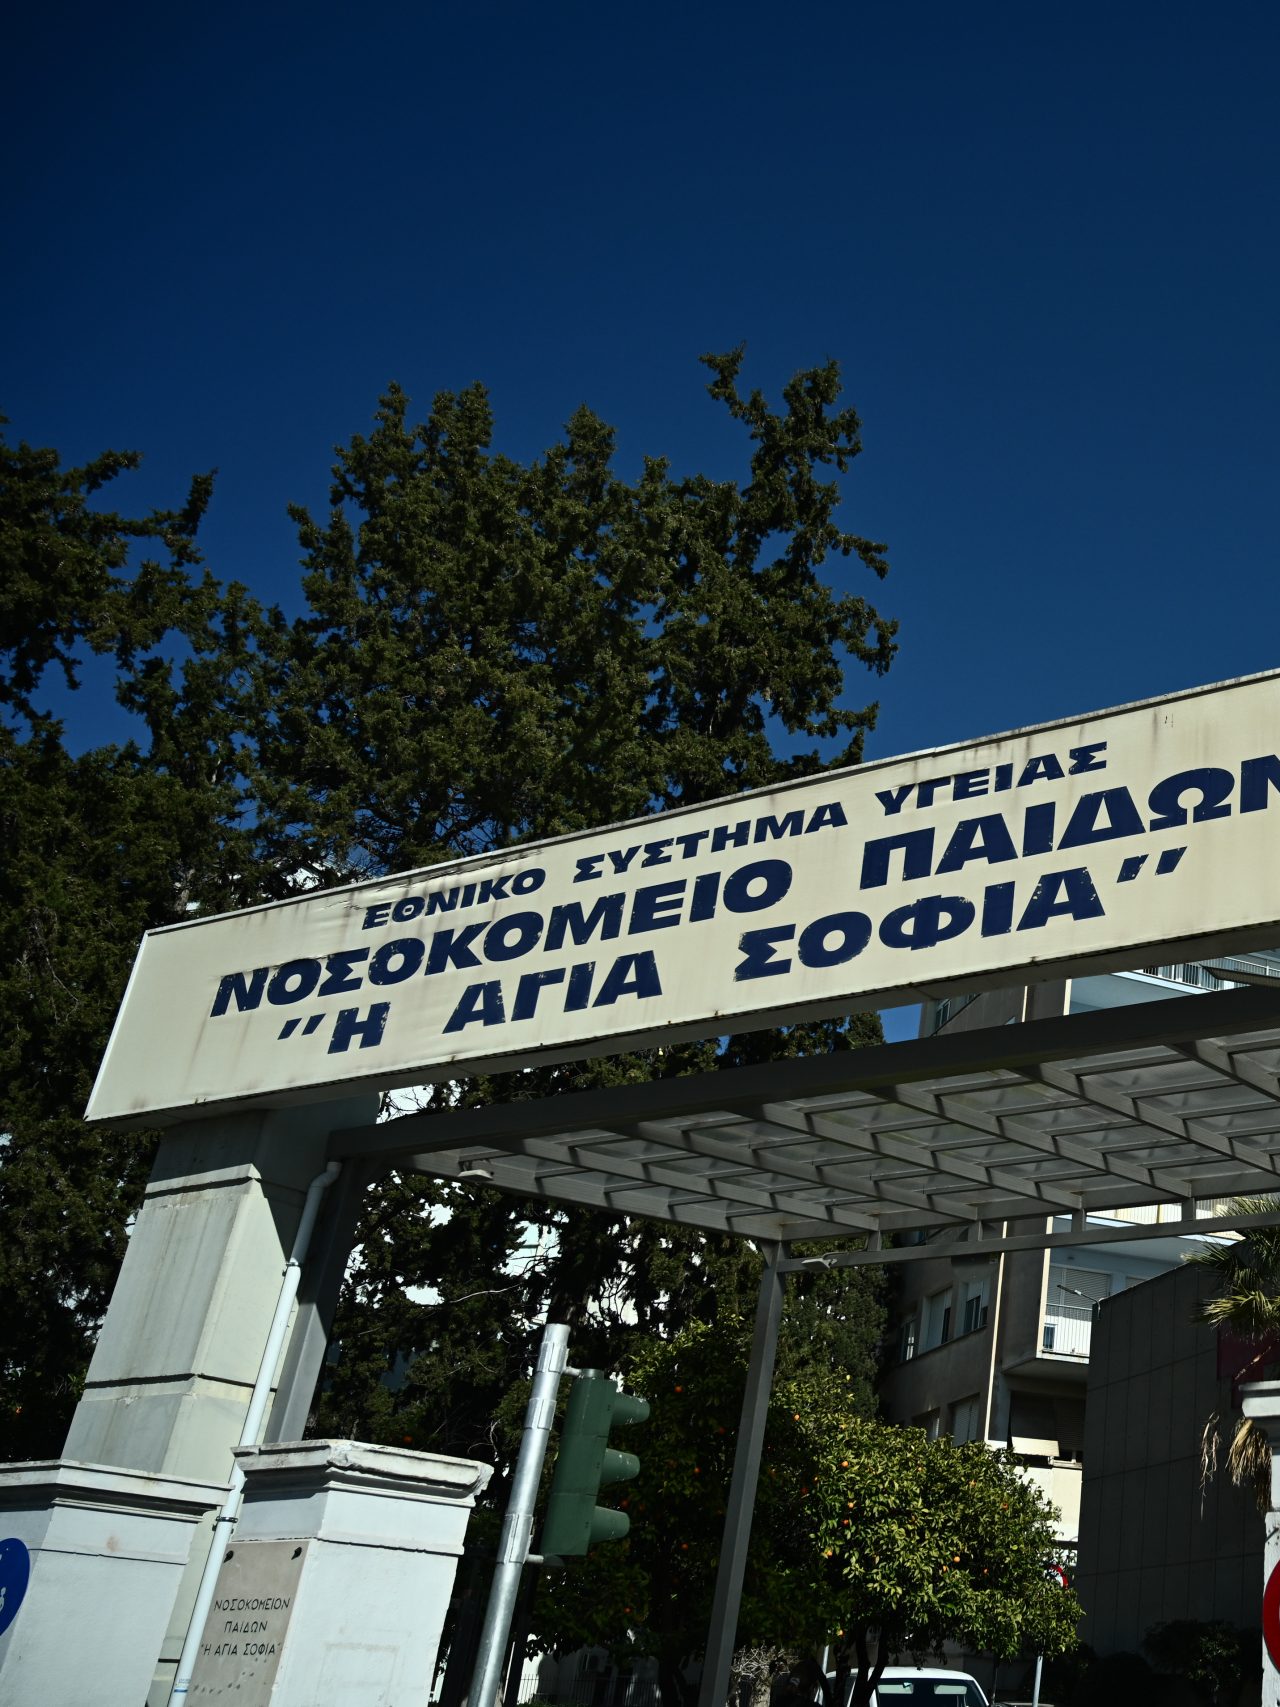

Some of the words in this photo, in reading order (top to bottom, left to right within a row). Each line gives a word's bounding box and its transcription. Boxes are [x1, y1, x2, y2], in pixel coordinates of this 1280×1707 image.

[361, 867, 546, 931] ΕΘΝΙΚΟ
[573, 801, 849, 884] ΣΥΣΤΗΜΑ
[875, 741, 1107, 816] ΥΓΕΙΑΣ
[210, 858, 793, 1018] ΝΟΣΟΚΟΜΕΙΟ
[443, 949, 662, 1035] ΑΓΙΑ
[214, 1597, 291, 1611] ΝΟΣΟΚΟΜΕΙΟΝ
[224, 1620, 268, 1634] ΠΑΙΔΩΝ
[214, 1643, 238, 1656] ΑΓΙΑ
